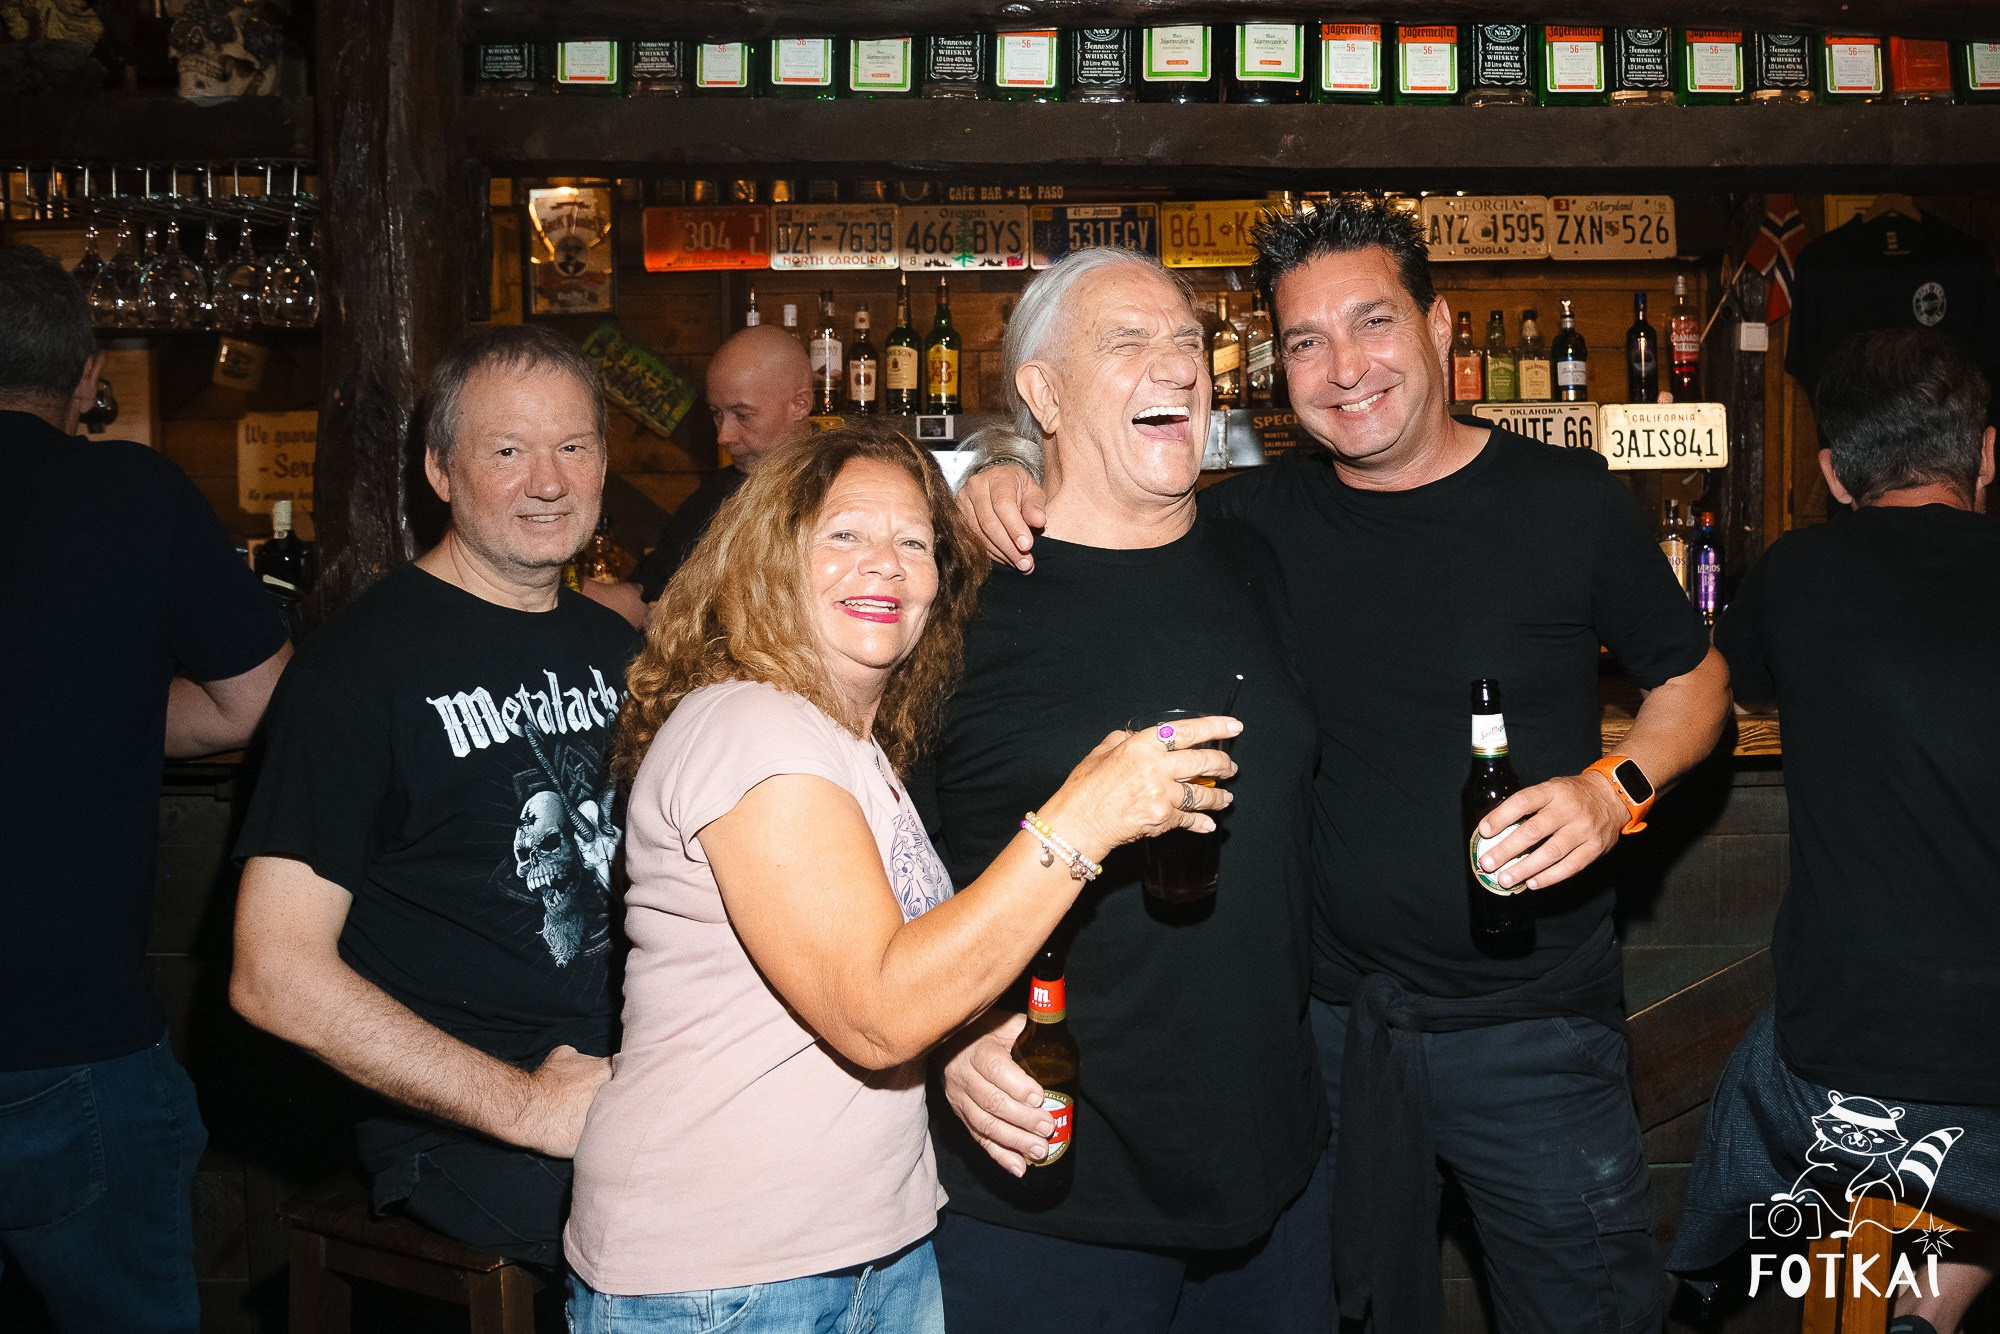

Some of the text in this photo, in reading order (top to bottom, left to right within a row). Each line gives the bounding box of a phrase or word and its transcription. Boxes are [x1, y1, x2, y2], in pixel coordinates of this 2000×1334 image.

[938, 38, 973, 46] Tennessee
[1021, 40, 1031, 49] 56
[1346, 43, 1356, 52] 56
[1486, 43, 1520, 51] Tennessee
[1423, 46, 1433, 55] 56
[1570, 45, 1579, 53] 56
[1709, 46, 1719, 54] 56
[981, 187, 1002, 200] BAR
[1019, 186, 1032, 199] EL
[1038, 186, 1064, 199] PASO
[1452, 199, 1520, 211] GEORGIA
[1560, 200, 1634, 214] 3 Maryland
[940, 207, 986, 219] Oregon
[1171, 213, 1217, 247] 861
[1430, 213, 1544, 244] AYZ 1595
[1556, 215, 1669, 244] ZXN 526
[685, 221, 732, 251] 304
[777, 222, 893, 254] DZF-7639
[906, 220, 1022, 254] 466 BYS
[1464, 246, 1509, 254] DOUGLAS
[783, 256, 886, 265] NORTH CAROLINA
[1632, 414, 1695, 423] CALIFORNIA
[1564, 416, 1592, 448] 66
[1611, 428, 1719, 458] 3AIS841
[1698, 564, 1721, 574] LARIOS
